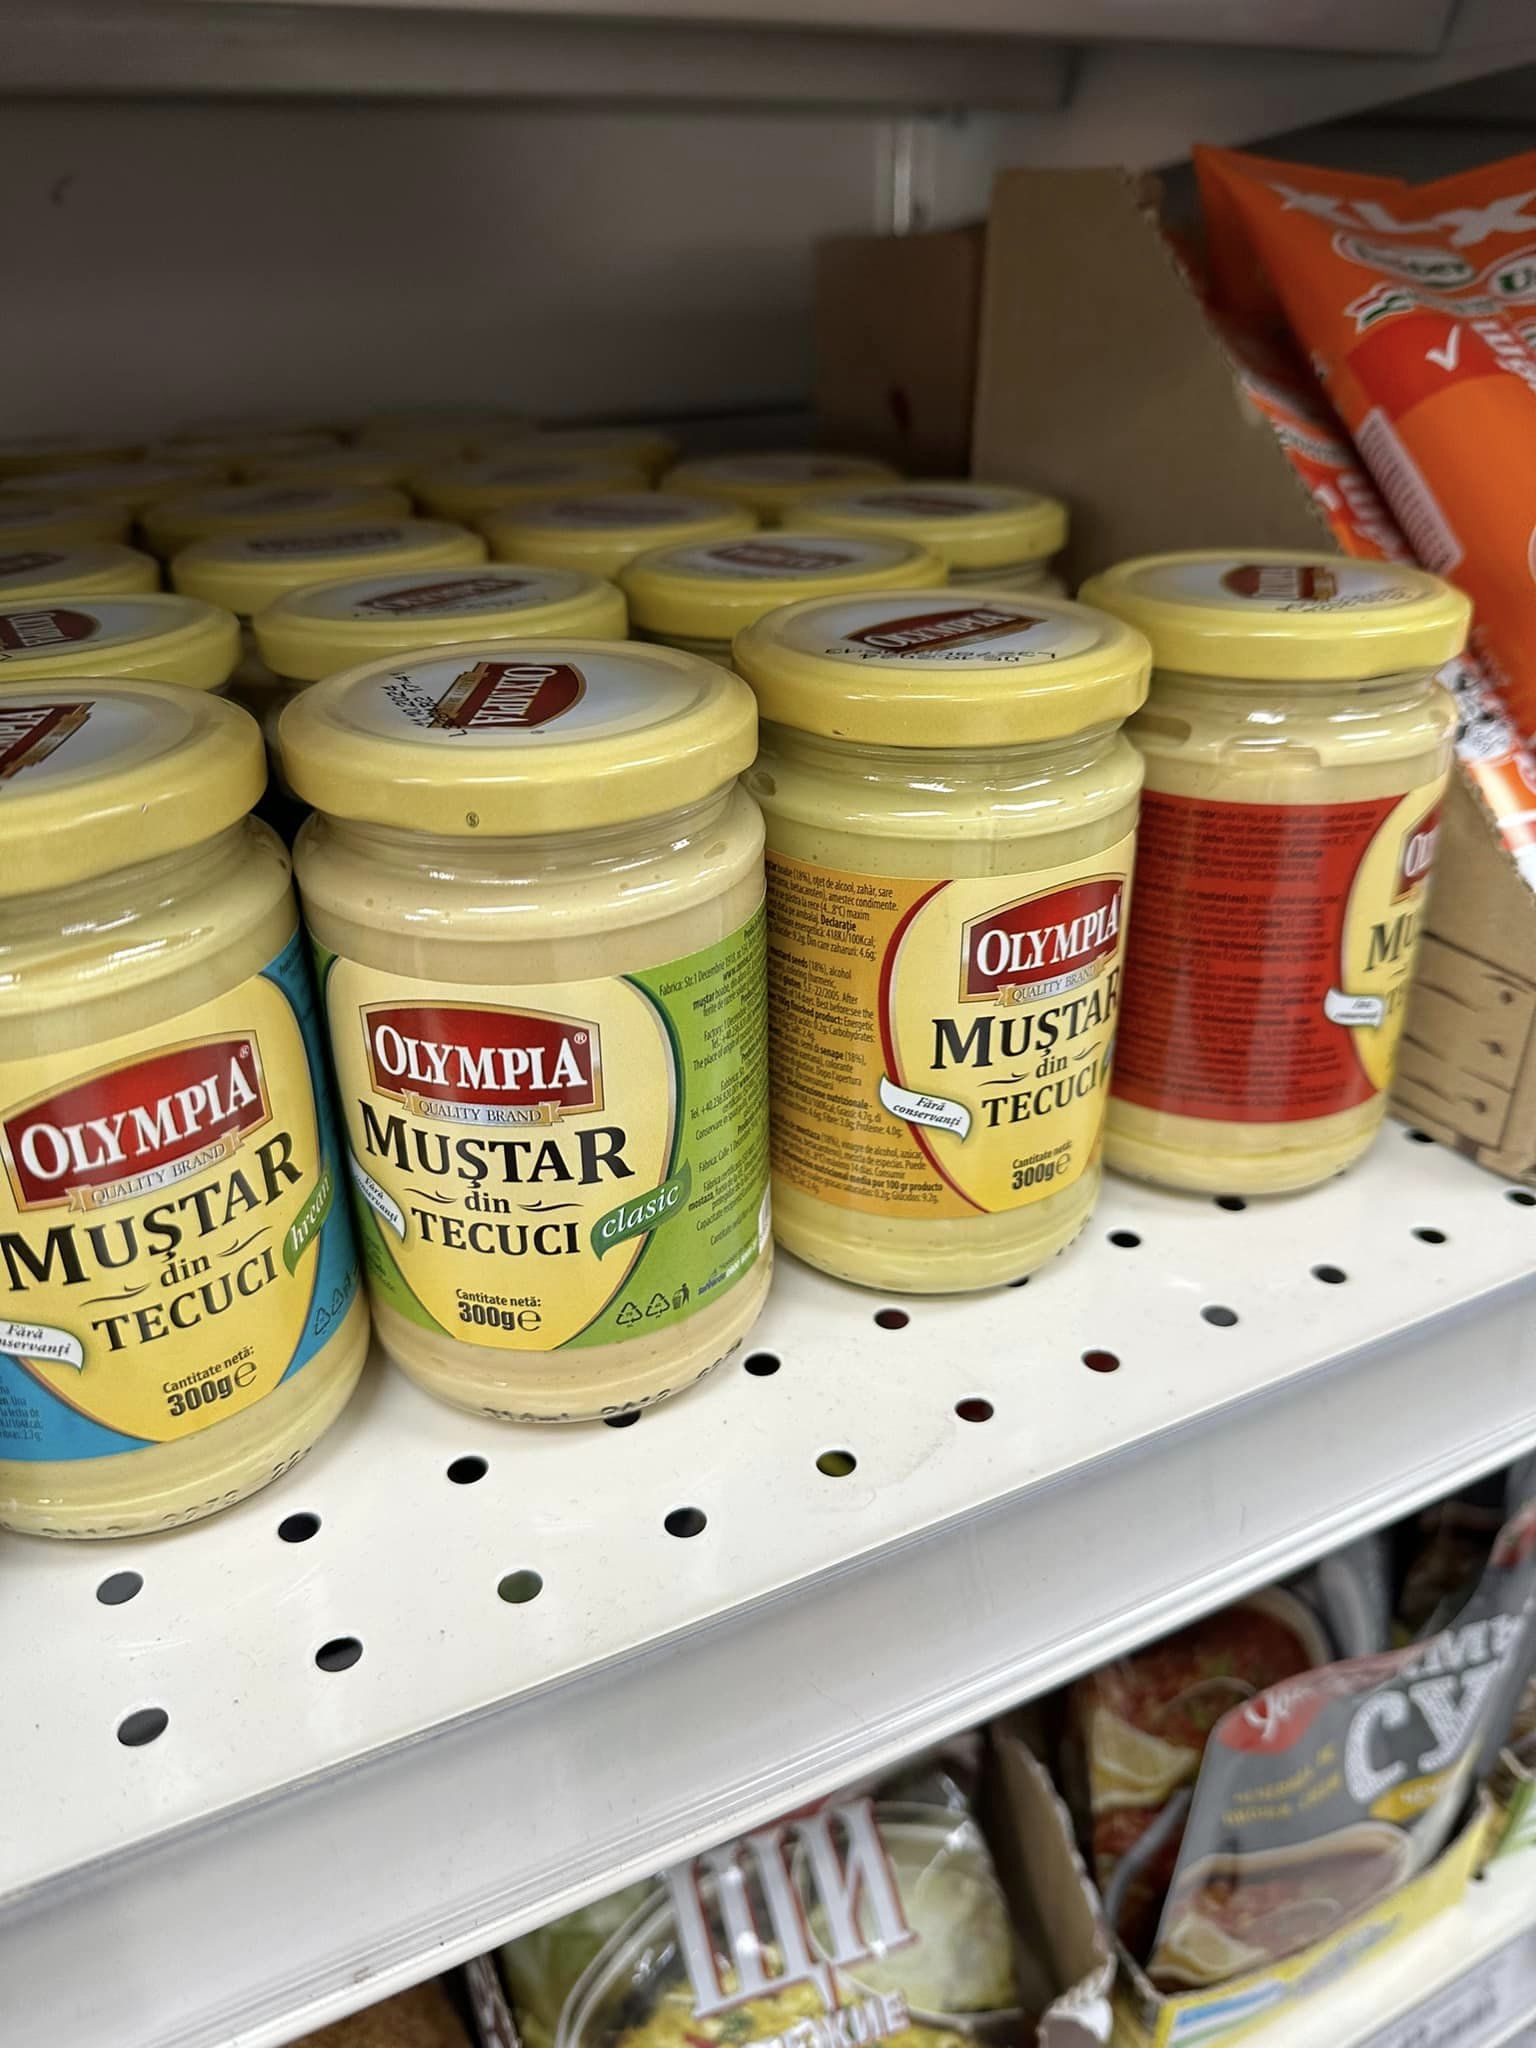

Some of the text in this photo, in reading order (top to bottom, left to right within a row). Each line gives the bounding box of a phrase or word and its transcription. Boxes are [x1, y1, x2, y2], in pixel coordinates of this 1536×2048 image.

[468, 666, 557, 726] OLYMPIA
[878, 888, 894, 898] sare
[976, 900, 1121, 977] OLYMPIA
[1011, 980, 1062, 1002] QUALITY
[374, 1024, 588, 1091] OLYMPIA
[1035, 1052, 1068, 1080] din
[915, 1096, 946, 1112] Fără
[982, 1058, 1098, 1128] TECUCI
[21, 1055, 257, 1180] OLYMPIA
[418, 1100, 542, 1123] QUALITY BRAND
[91, 1142, 226, 1203] QUALITY BRAND
[1012, 1147, 1051, 1170] Cantitate
[909, 1180, 943, 1193] producto
[1012, 1161, 1057, 1191] 300g
[289, 1174, 331, 1251] hrean
[464, 1190, 512, 1214] din
[602, 1182, 680, 1238] clasic
[411, 1207, 581, 1256] TECUCI
[160, 1252, 213, 1288] din
[92, 1246, 279, 1352] TECUCI
[455, 1289, 508, 1307] Cantitate
[7, 1324, 44, 1340] Fără
[458, 1301, 516, 1331] 300g
[162, 1360, 222, 1394] Cantitate
[167, 1374, 234, 1417] 300g
